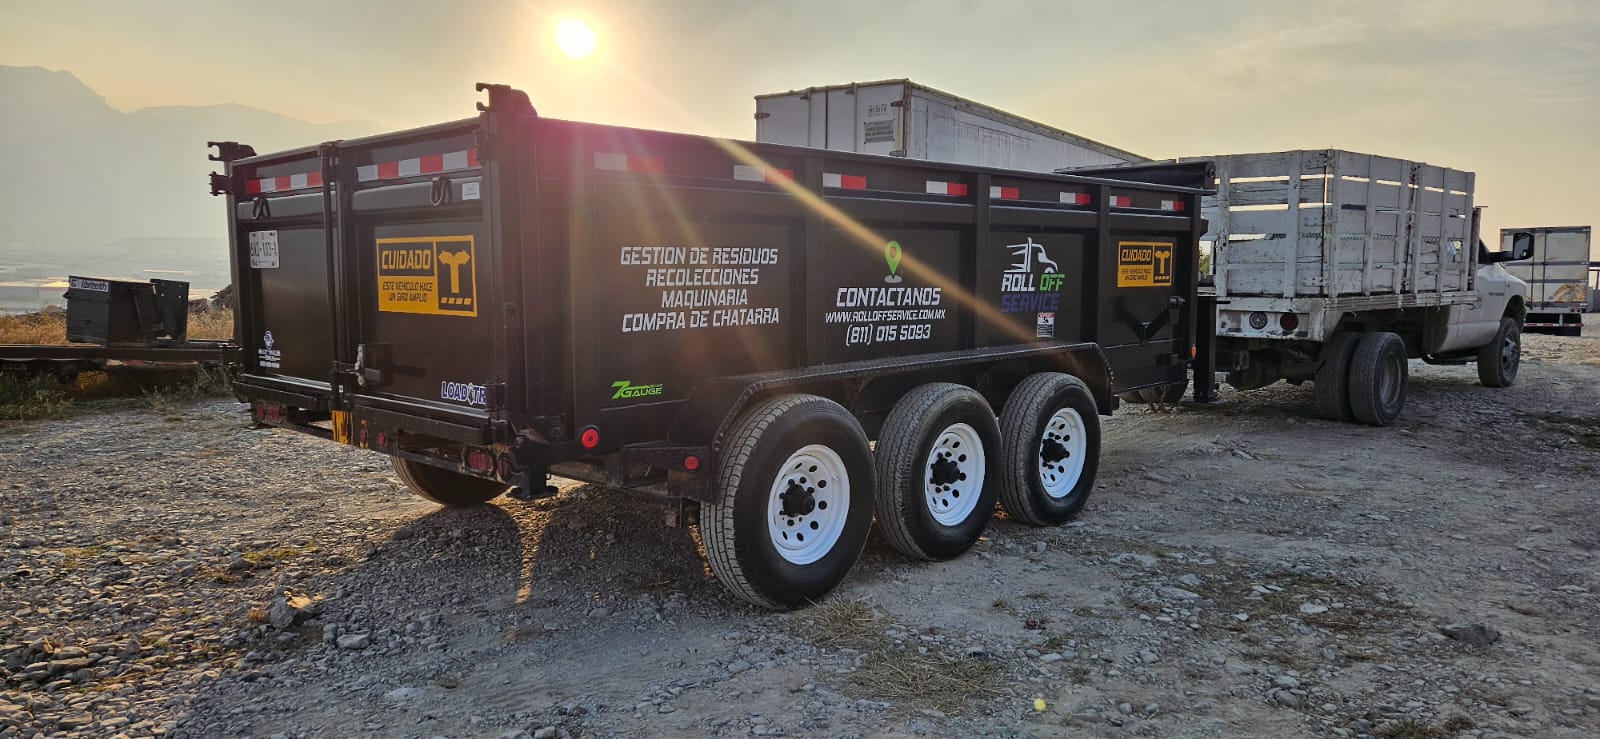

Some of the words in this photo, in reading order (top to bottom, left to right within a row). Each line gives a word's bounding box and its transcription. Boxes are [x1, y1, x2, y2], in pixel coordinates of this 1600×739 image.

[382, 249, 432, 270] CUIDADO
[621, 247, 686, 265] GESTION
[689, 247, 709, 265] DE
[712, 248, 779, 265] RESIDUOS
[1121, 249, 1152, 262] CUIDADO
[383, 281, 395, 291] ESTE
[396, 281, 419, 291] VEHICULO
[420, 282, 433, 291] HACE
[646, 268, 760, 287] RECOLECCIONES
[1001, 273, 1036, 292] ROLL
[1039, 273, 1066, 291] OFF
[661, 289, 748, 310] MAQUINARIA
[836, 287, 942, 307] CONTACTANOS
[1001, 293, 1059, 313] SERVICE
[622, 312, 686, 333] COMPRA
[690, 311, 709, 328] DE
[712, 308, 780, 327] CHATARRA
[825, 309, 946, 324] WWW.ROLLOFFSERVICE.COM.MX
[846, 323, 873, 346] (811)
[876, 325, 897, 342] 015
[899, 324, 931, 341] 5093
[441, 381, 469, 402] LOAD
[611, 380, 630, 400] 7
[621, 387, 662, 399] GAUGE
